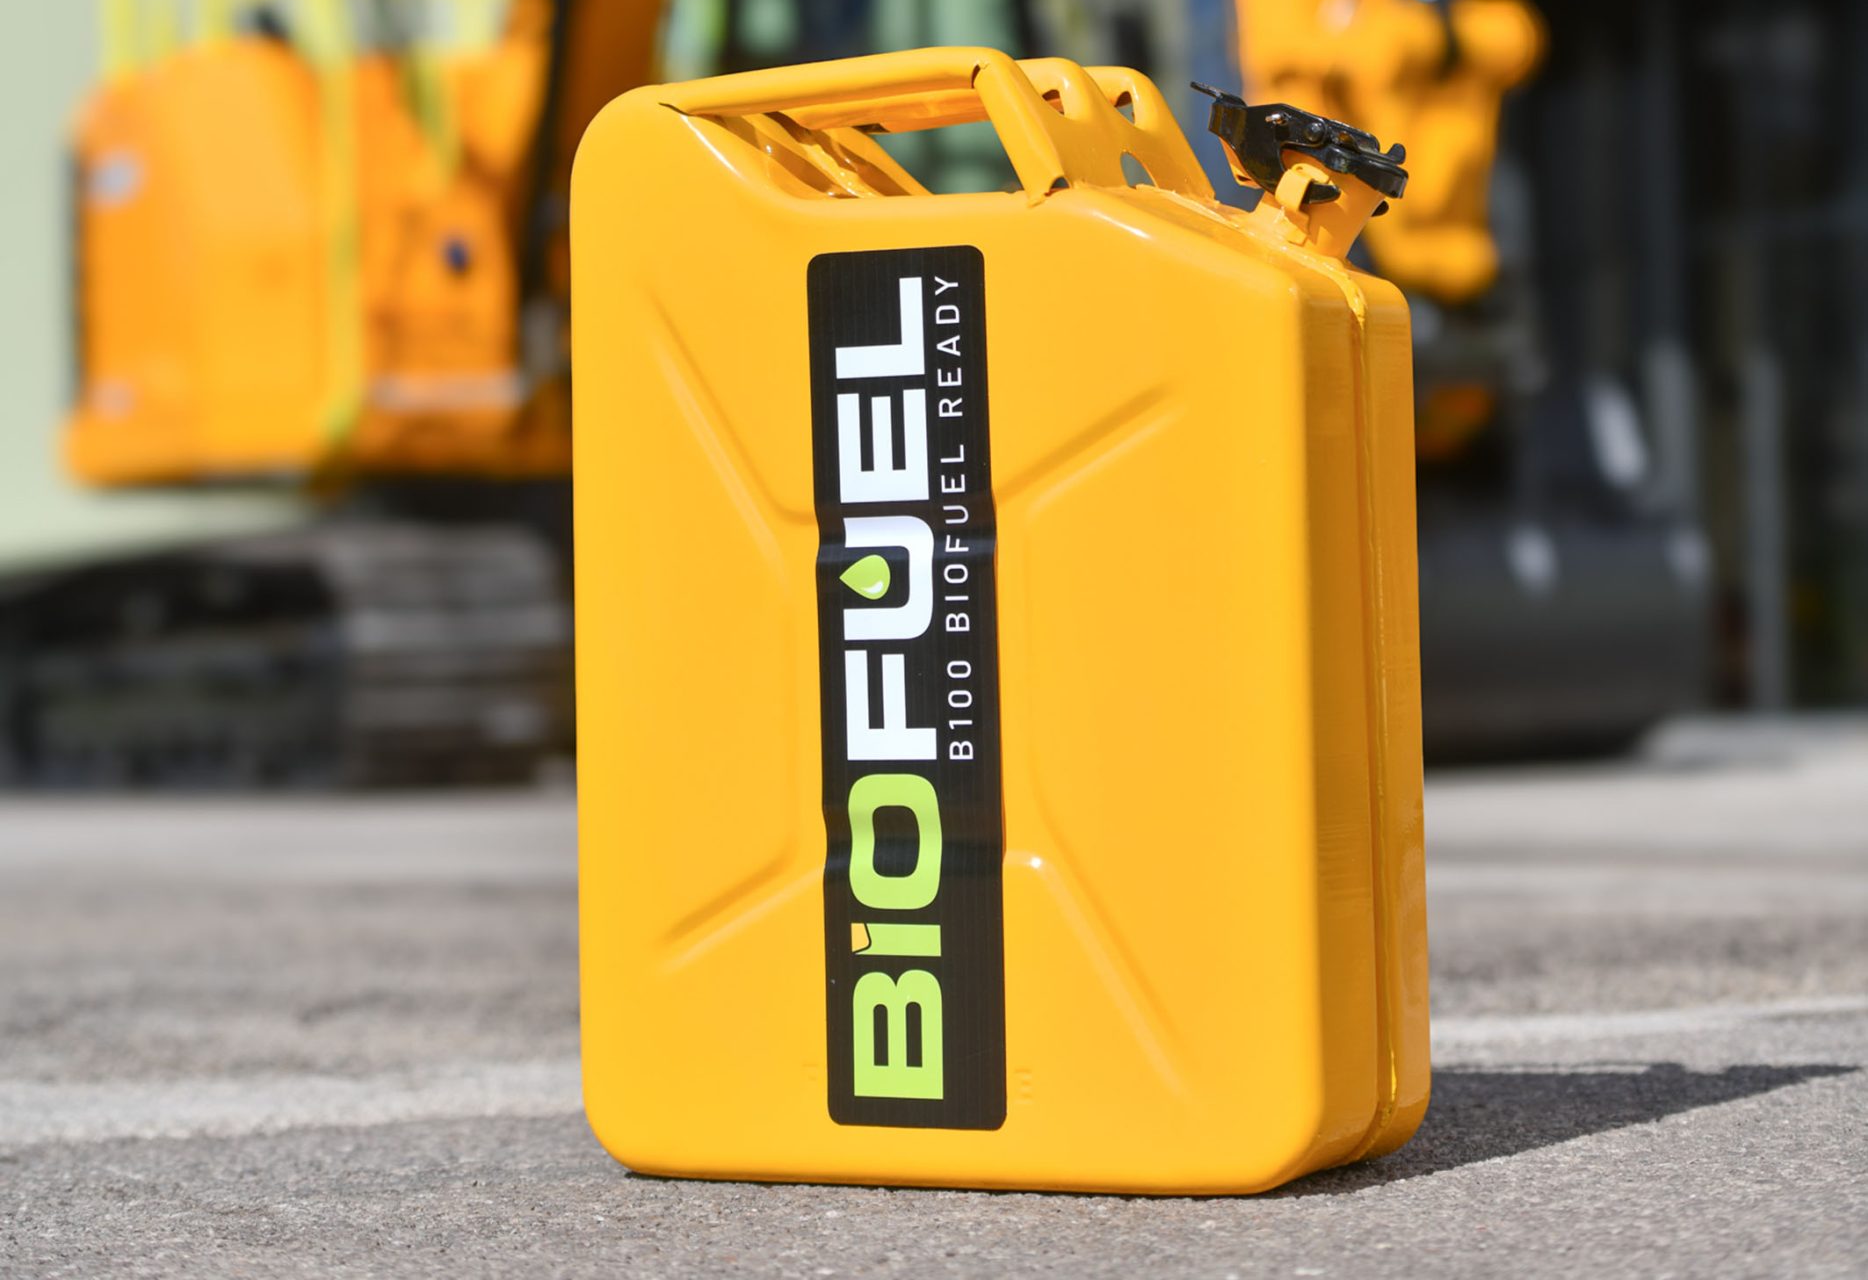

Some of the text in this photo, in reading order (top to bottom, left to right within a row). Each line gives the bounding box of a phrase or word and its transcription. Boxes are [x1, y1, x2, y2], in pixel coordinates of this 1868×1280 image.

[833, 275, 944, 1101] BIOFUEL
[934, 275, 974, 761] B100 BIOFUEL READY
